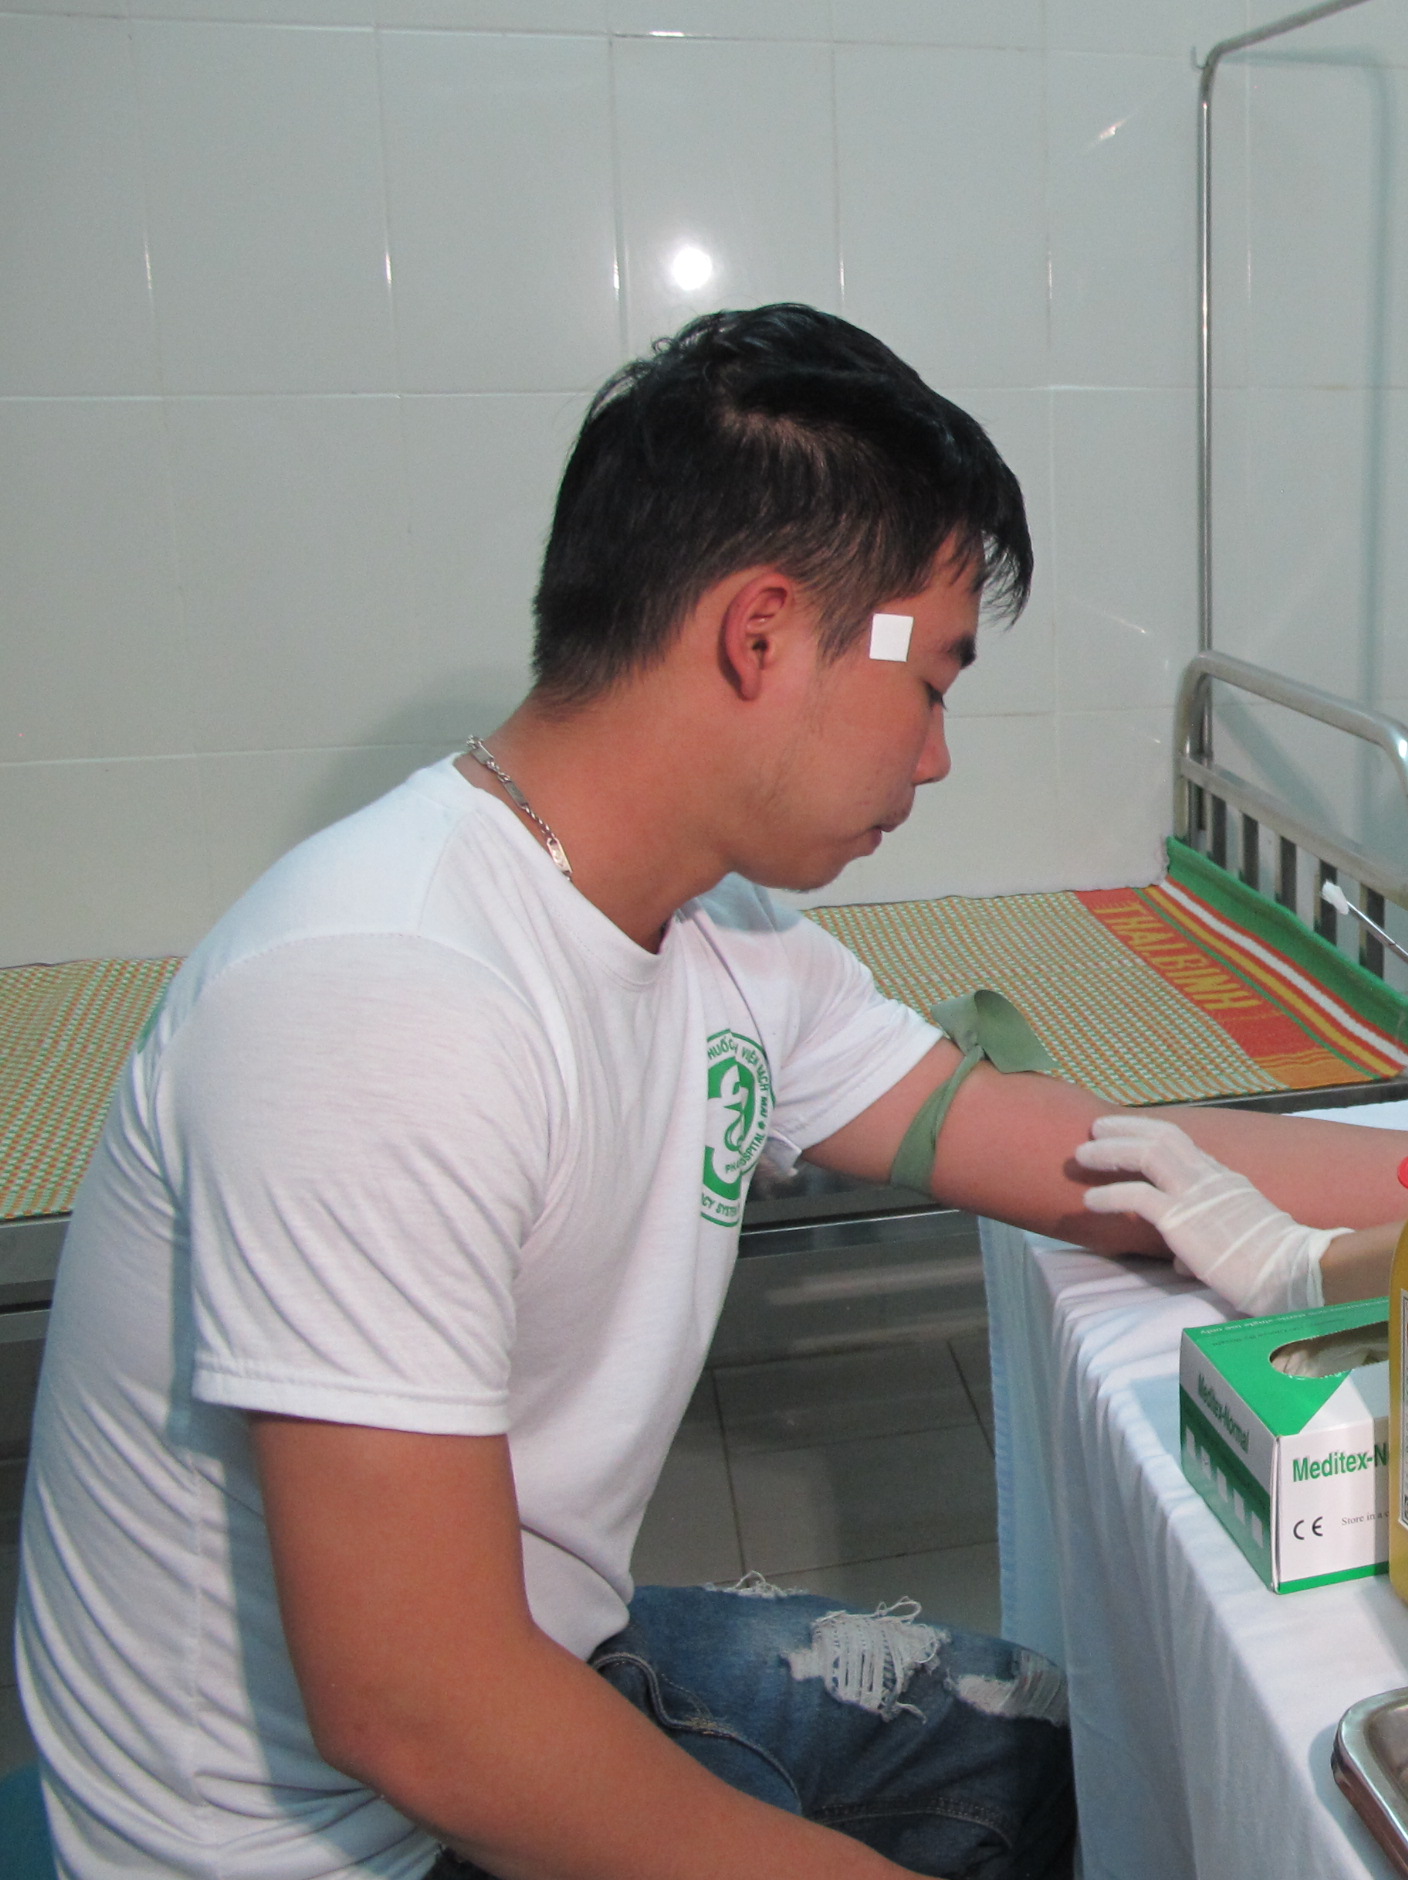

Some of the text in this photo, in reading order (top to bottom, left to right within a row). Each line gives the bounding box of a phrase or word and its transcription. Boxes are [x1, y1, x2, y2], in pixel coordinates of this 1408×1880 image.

[1292, 1443, 1389, 1482] Meditex-N
[1341, 1514, 1365, 1526] Store
[1366, 1511, 1375, 1521] in
